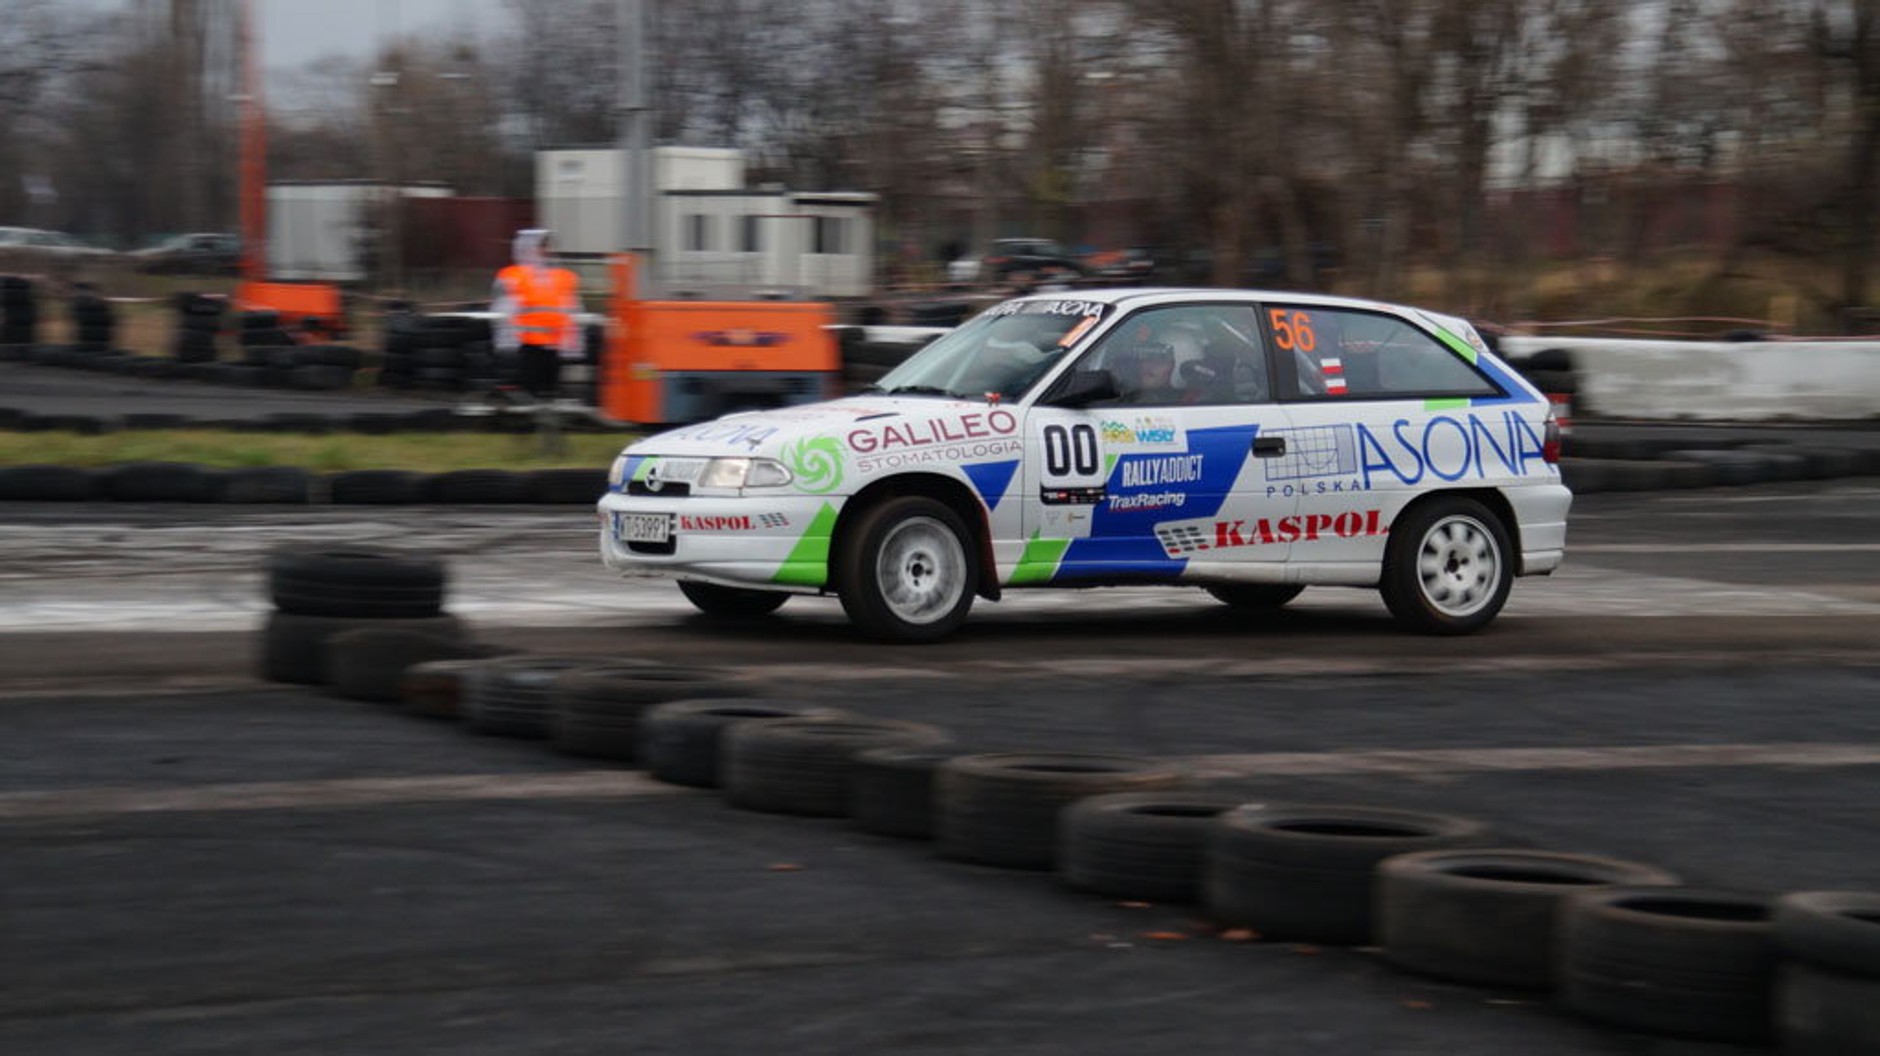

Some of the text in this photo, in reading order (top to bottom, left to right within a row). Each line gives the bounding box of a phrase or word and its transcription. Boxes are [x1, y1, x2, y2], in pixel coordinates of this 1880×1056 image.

[1269, 308, 1316, 352] 56
[848, 410, 1017, 453] GALILEO
[1357, 410, 1555, 490] ASONA
[858, 440, 1023, 473] STOMATOLOGIA
[1043, 424, 1099, 477] 00
[1122, 454, 1204, 488] RALLYADDICT
[1266, 479, 1362, 499] POLSKA
[1107, 490, 1186, 510] TraxRacing
[679, 514, 757, 531] KASPOL
[1214, 509, 1390, 549] KASPOL
